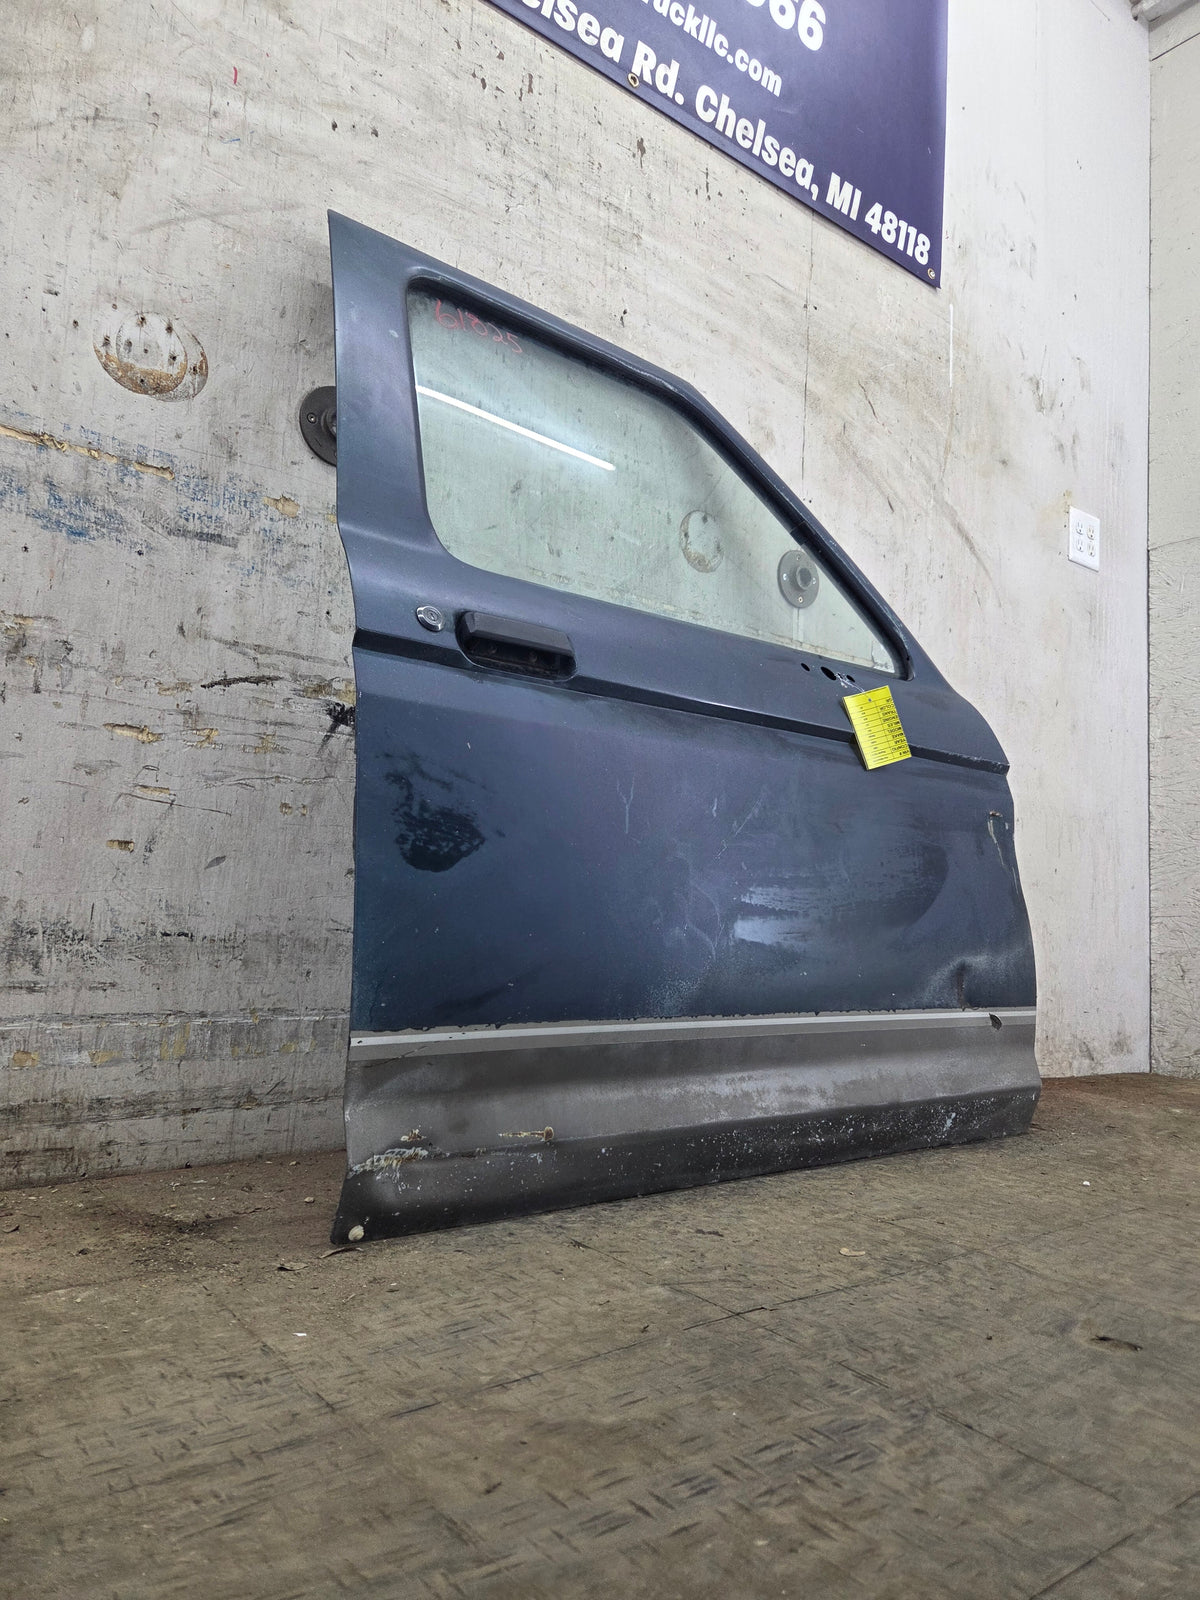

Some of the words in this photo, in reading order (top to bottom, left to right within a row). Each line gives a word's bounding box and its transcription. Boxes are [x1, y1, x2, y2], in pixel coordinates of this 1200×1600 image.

[641, 0, 783, 97] uckllc.com
[745, 0, 827, 51] 66
[522, 0, 625, 64] sea
[631, 40, 685, 105] Rd.
[695, 84, 819, 201] Chelsea,
[825, 172, 863, 222] MI
[864, 202, 931, 266] 48118
